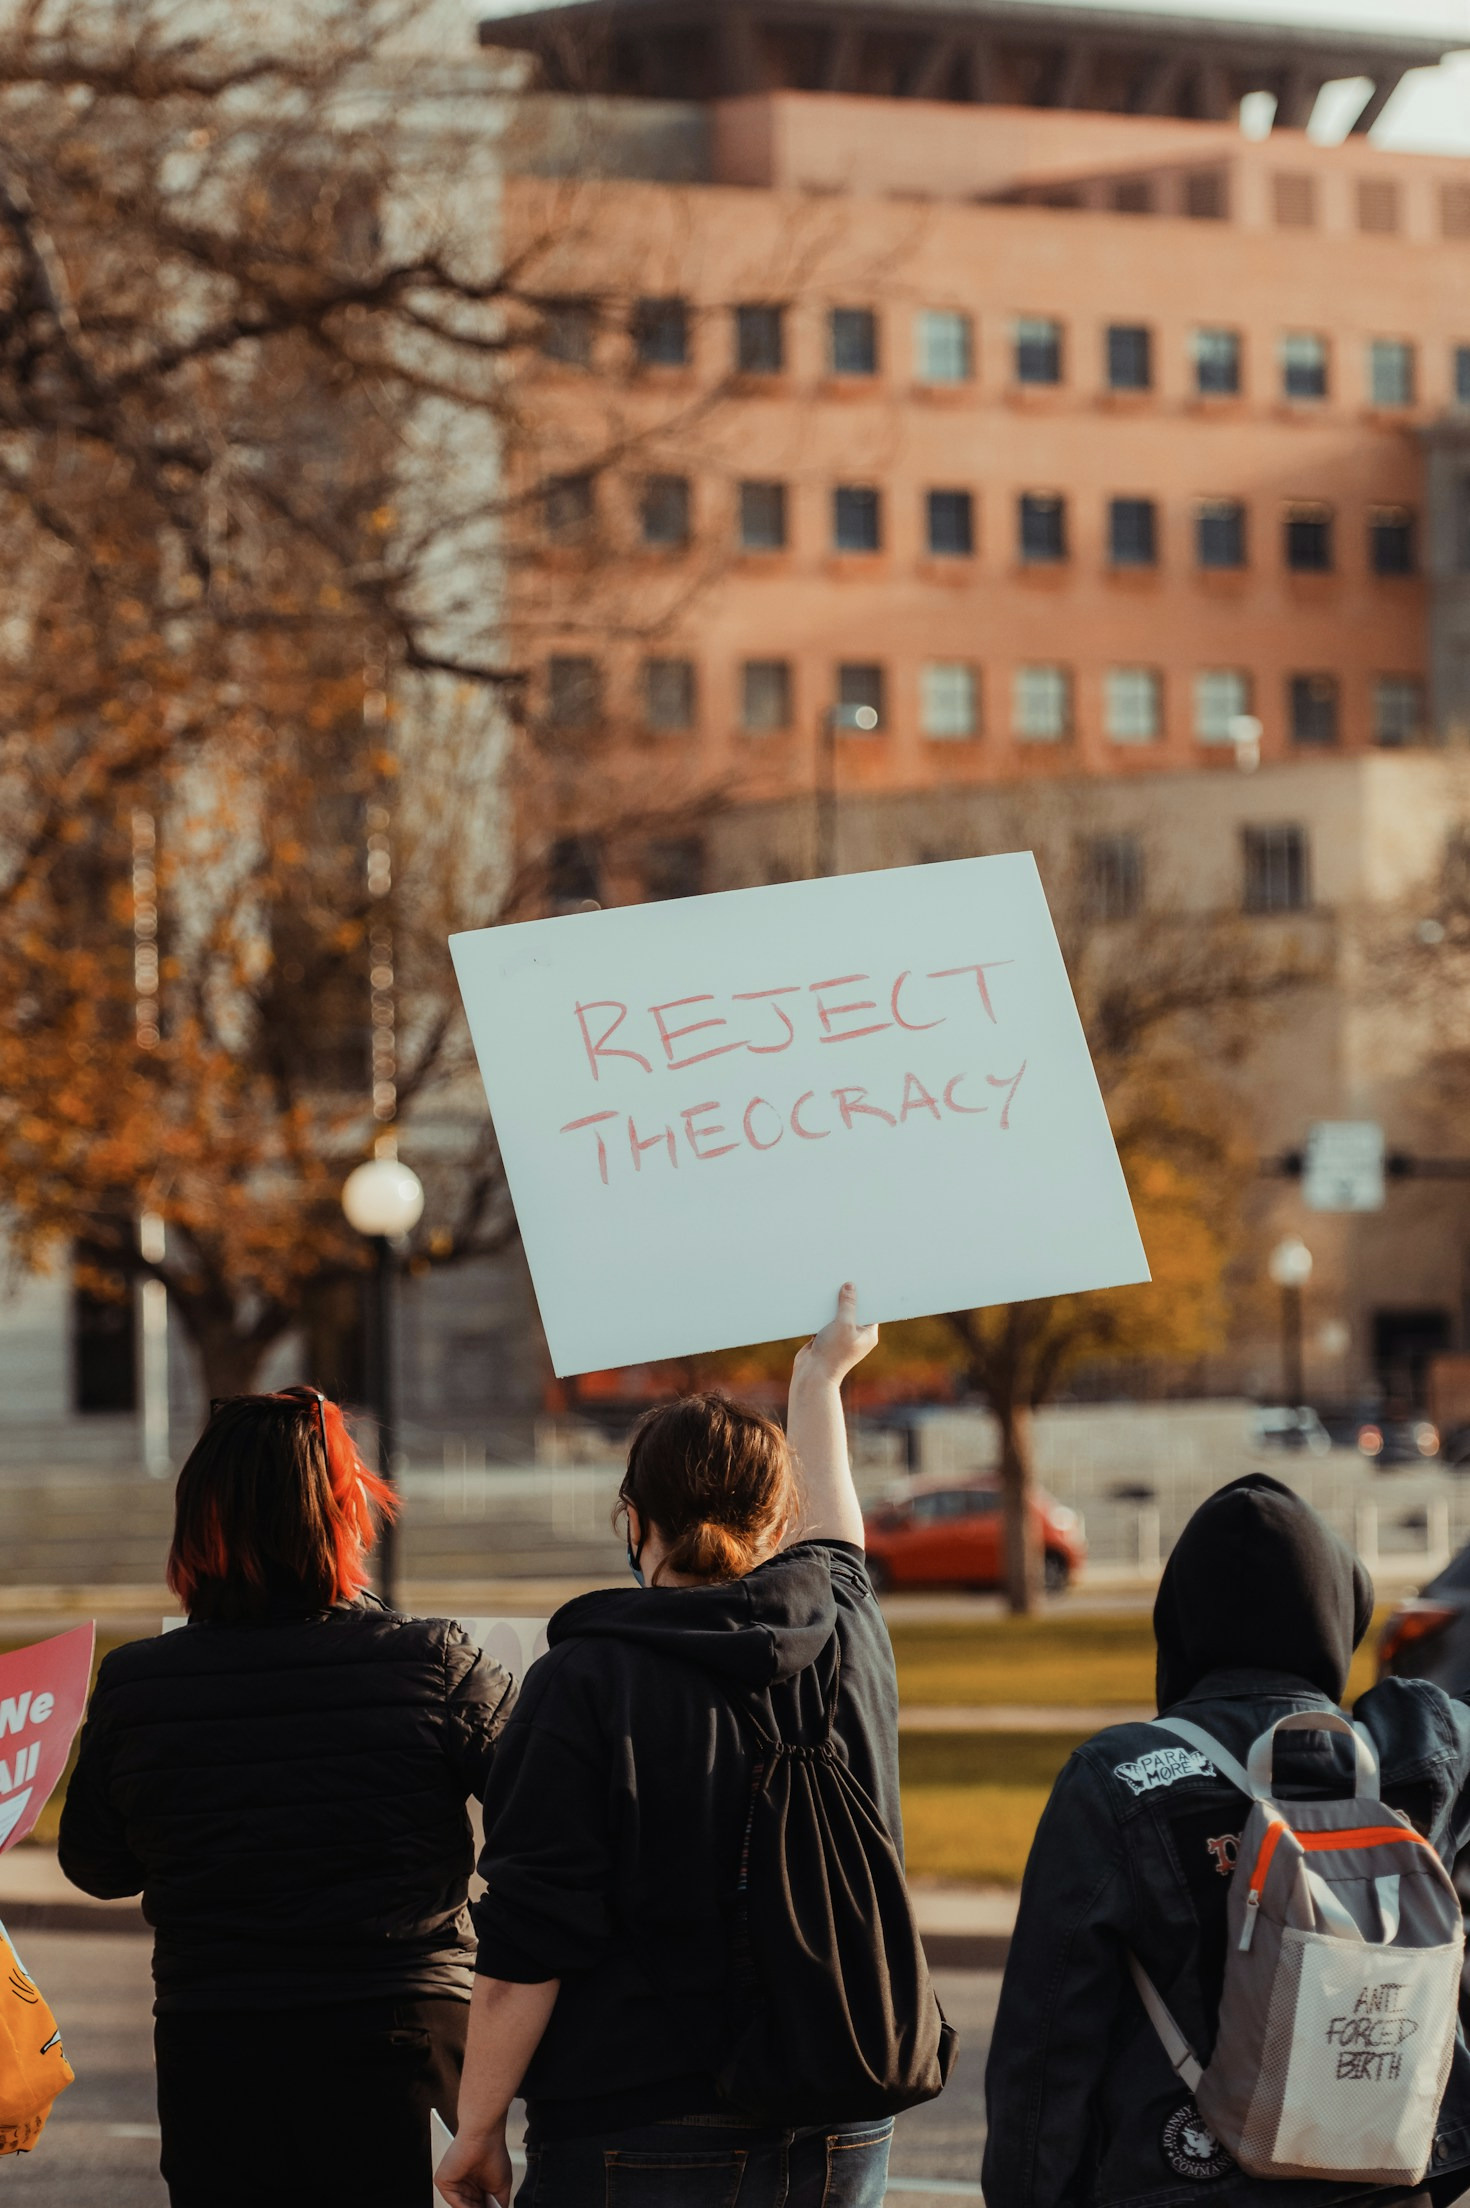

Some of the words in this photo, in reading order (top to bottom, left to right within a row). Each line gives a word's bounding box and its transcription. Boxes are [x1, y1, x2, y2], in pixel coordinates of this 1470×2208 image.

[573, 960, 1015, 1080] REJECT
[560, 1060, 1027, 1184] THEOCRACY
[1141, 1750, 1189, 1772] PARA
[1325, 2017, 1418, 2048] FORCED
[1336, 2051, 1403, 2081] BIRTH
[1163, 2105, 1192, 2149] JOHNNY
